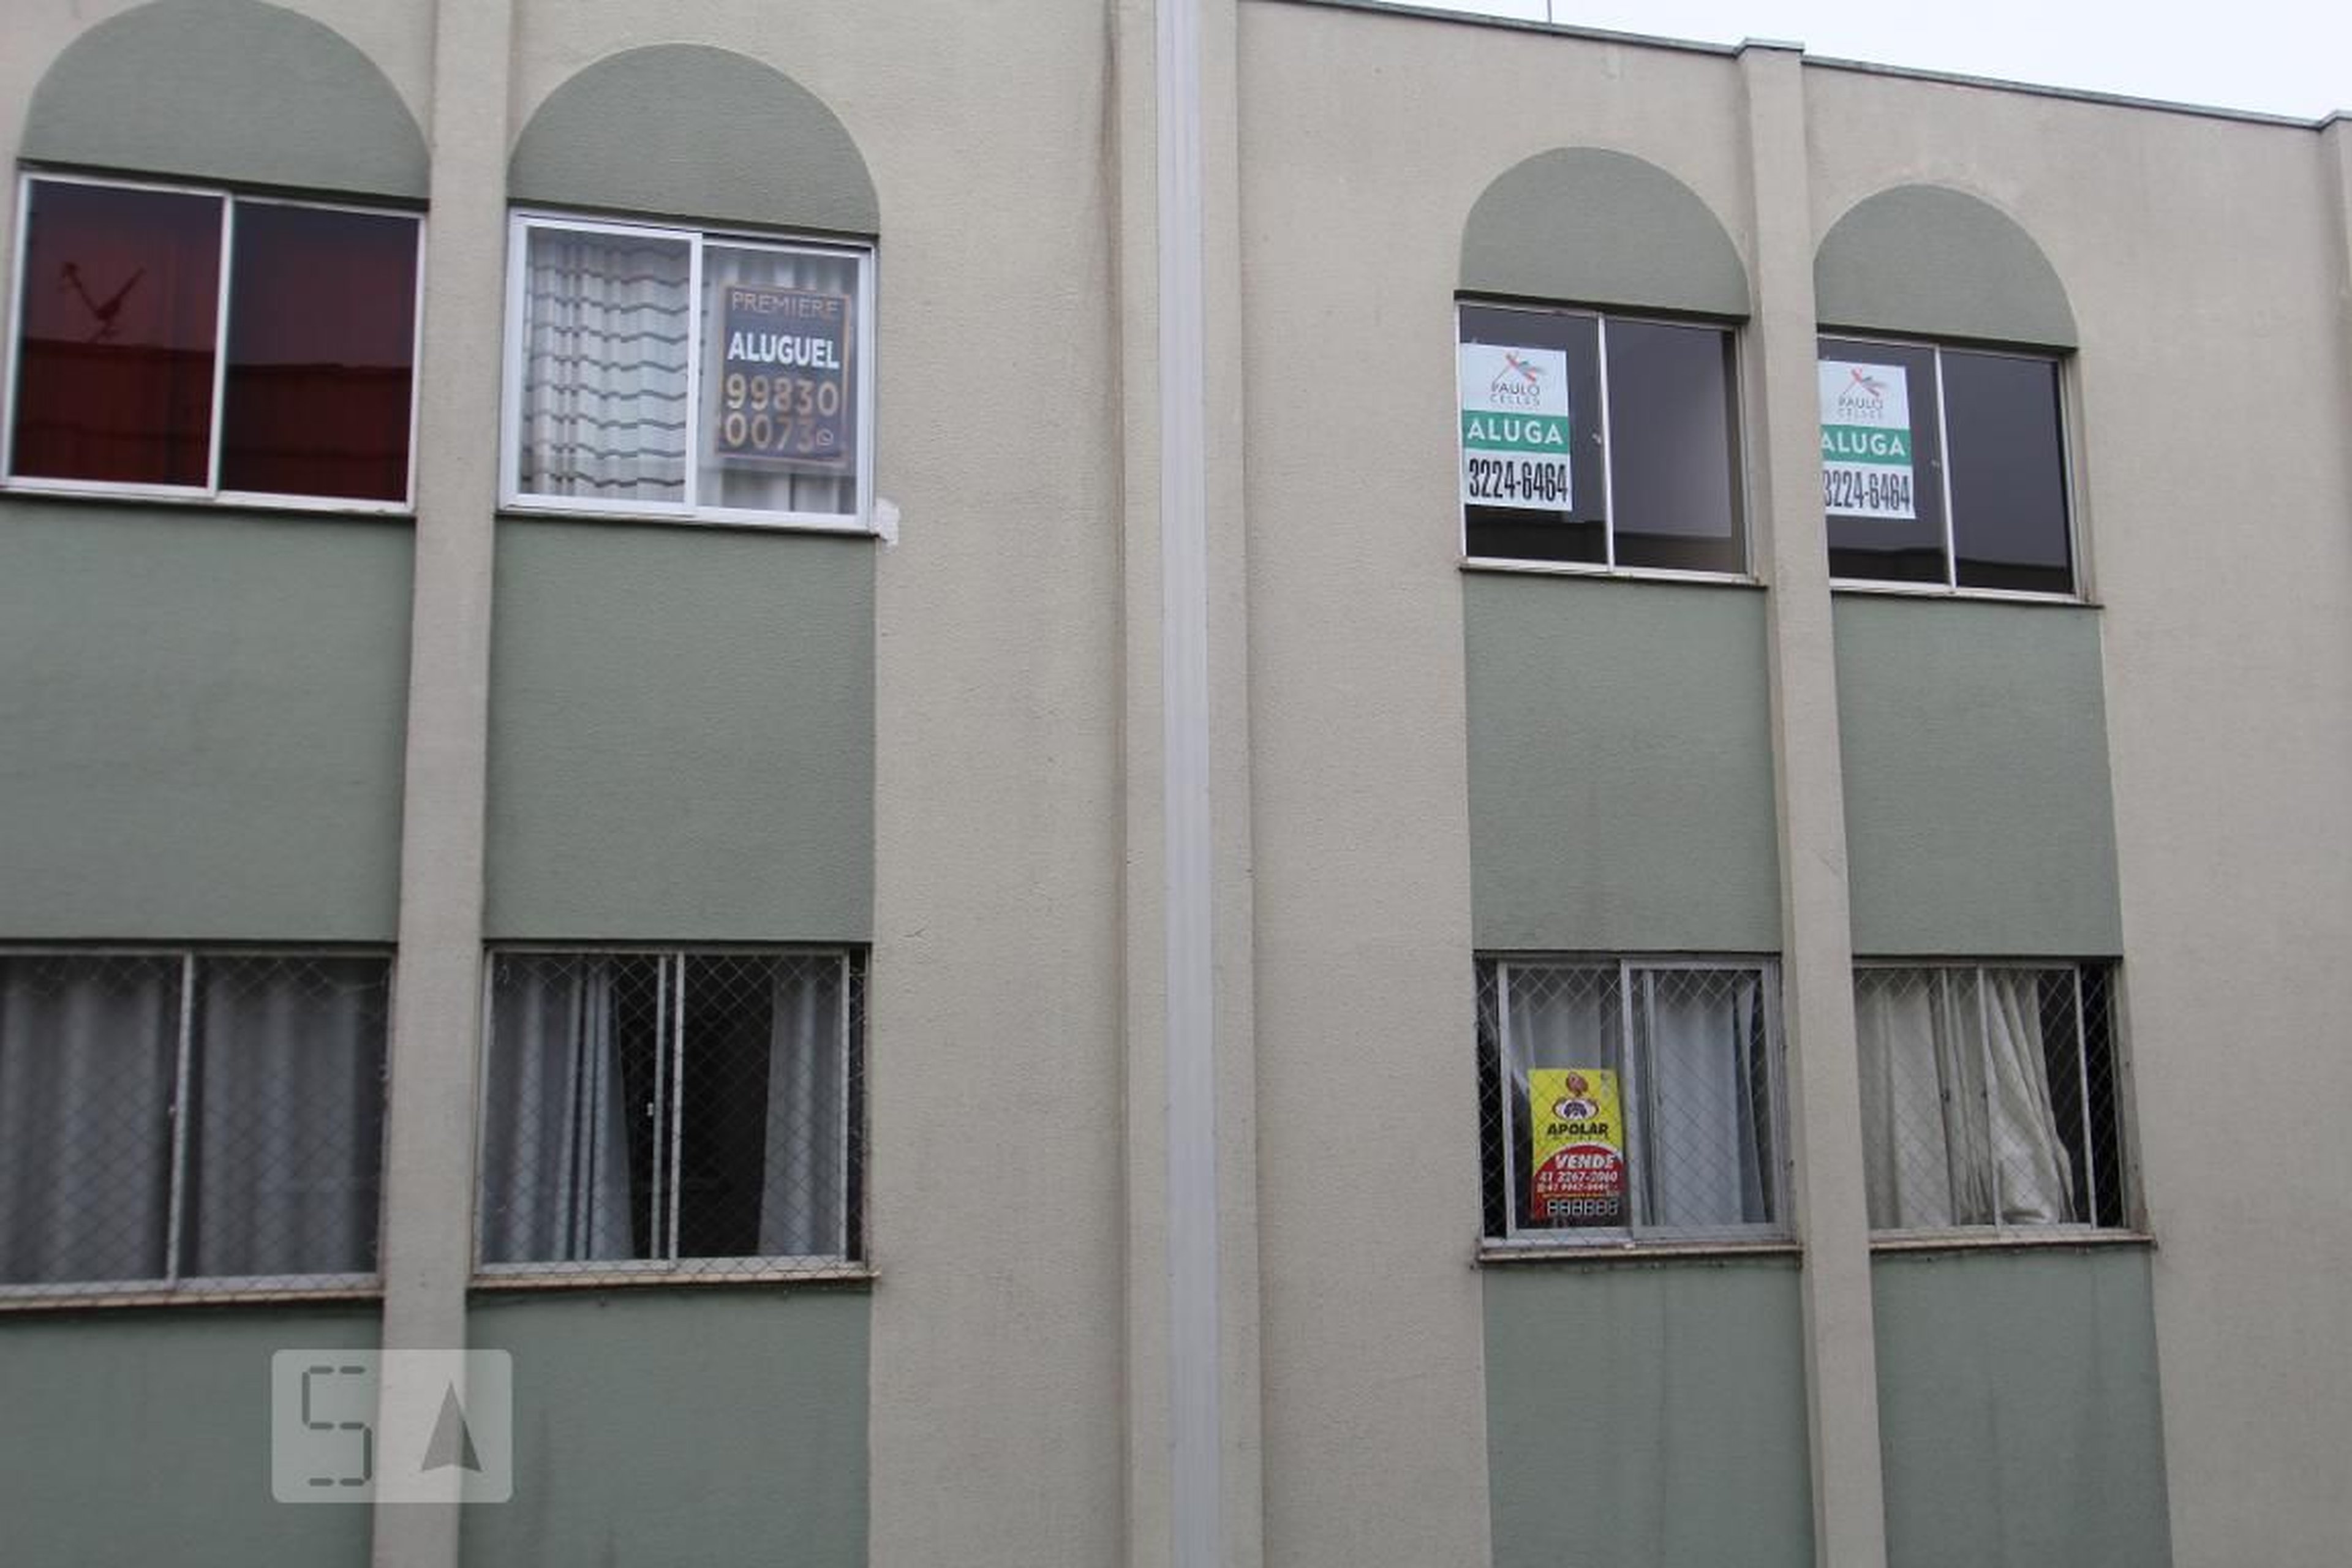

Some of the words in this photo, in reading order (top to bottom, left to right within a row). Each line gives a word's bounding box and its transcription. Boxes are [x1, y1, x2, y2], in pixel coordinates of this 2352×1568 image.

[732, 292, 839, 318] PREMIERE
[727, 332, 839, 369] ALUGUEL
[1491, 380, 1540, 396] PAULO
[1838, 396, 1883, 410] PAULO
[1468, 418, 1563, 445] ALUGA
[1822, 431, 1905, 456] ALUGA
[1469, 458, 1568, 502] 3224-6464
[1823, 470, 1910, 513] 3224-6464
[1547, 1122, 1610, 1137] APOLAR
[1555, 1154, 1616, 1169] VENDE
